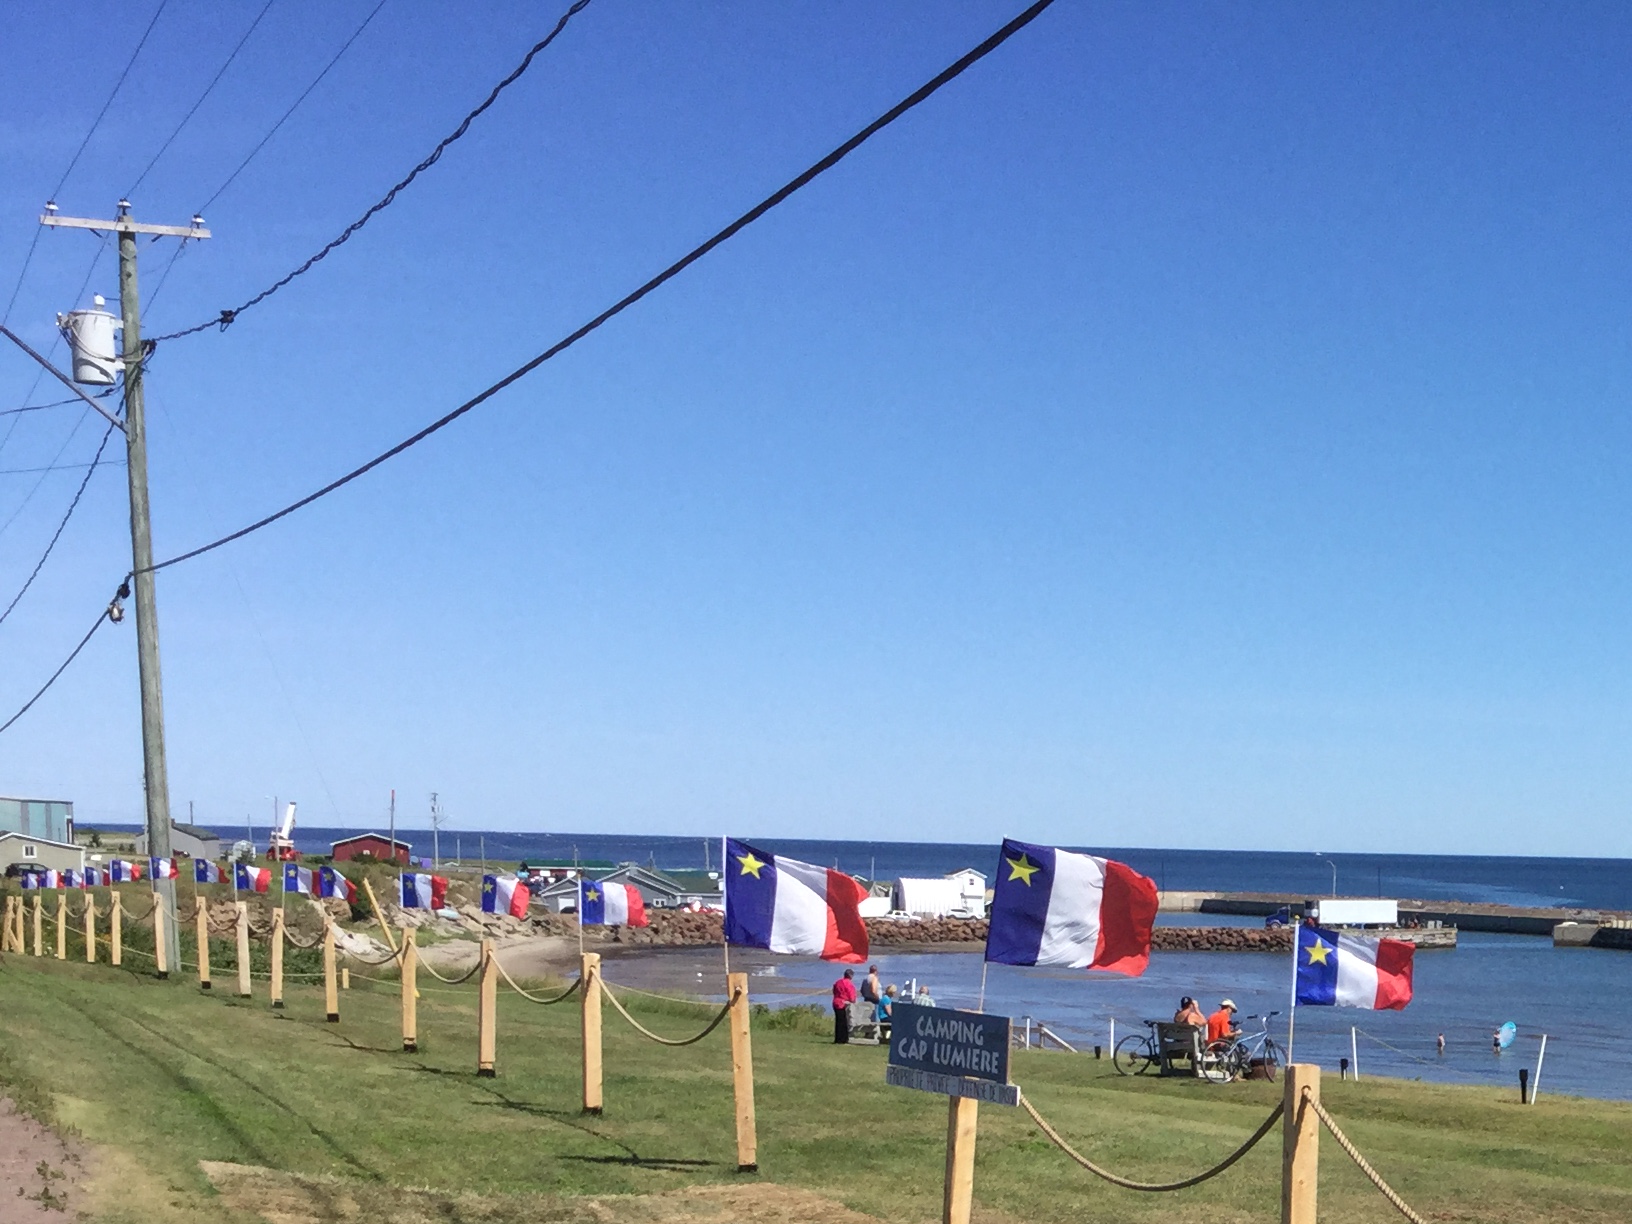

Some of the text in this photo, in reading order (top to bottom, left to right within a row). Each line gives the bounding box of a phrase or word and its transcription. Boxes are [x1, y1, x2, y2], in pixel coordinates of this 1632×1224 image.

[916, 1015, 984, 1046] CAMPING
[898, 1037, 1000, 1074] CAP LUMIERE
